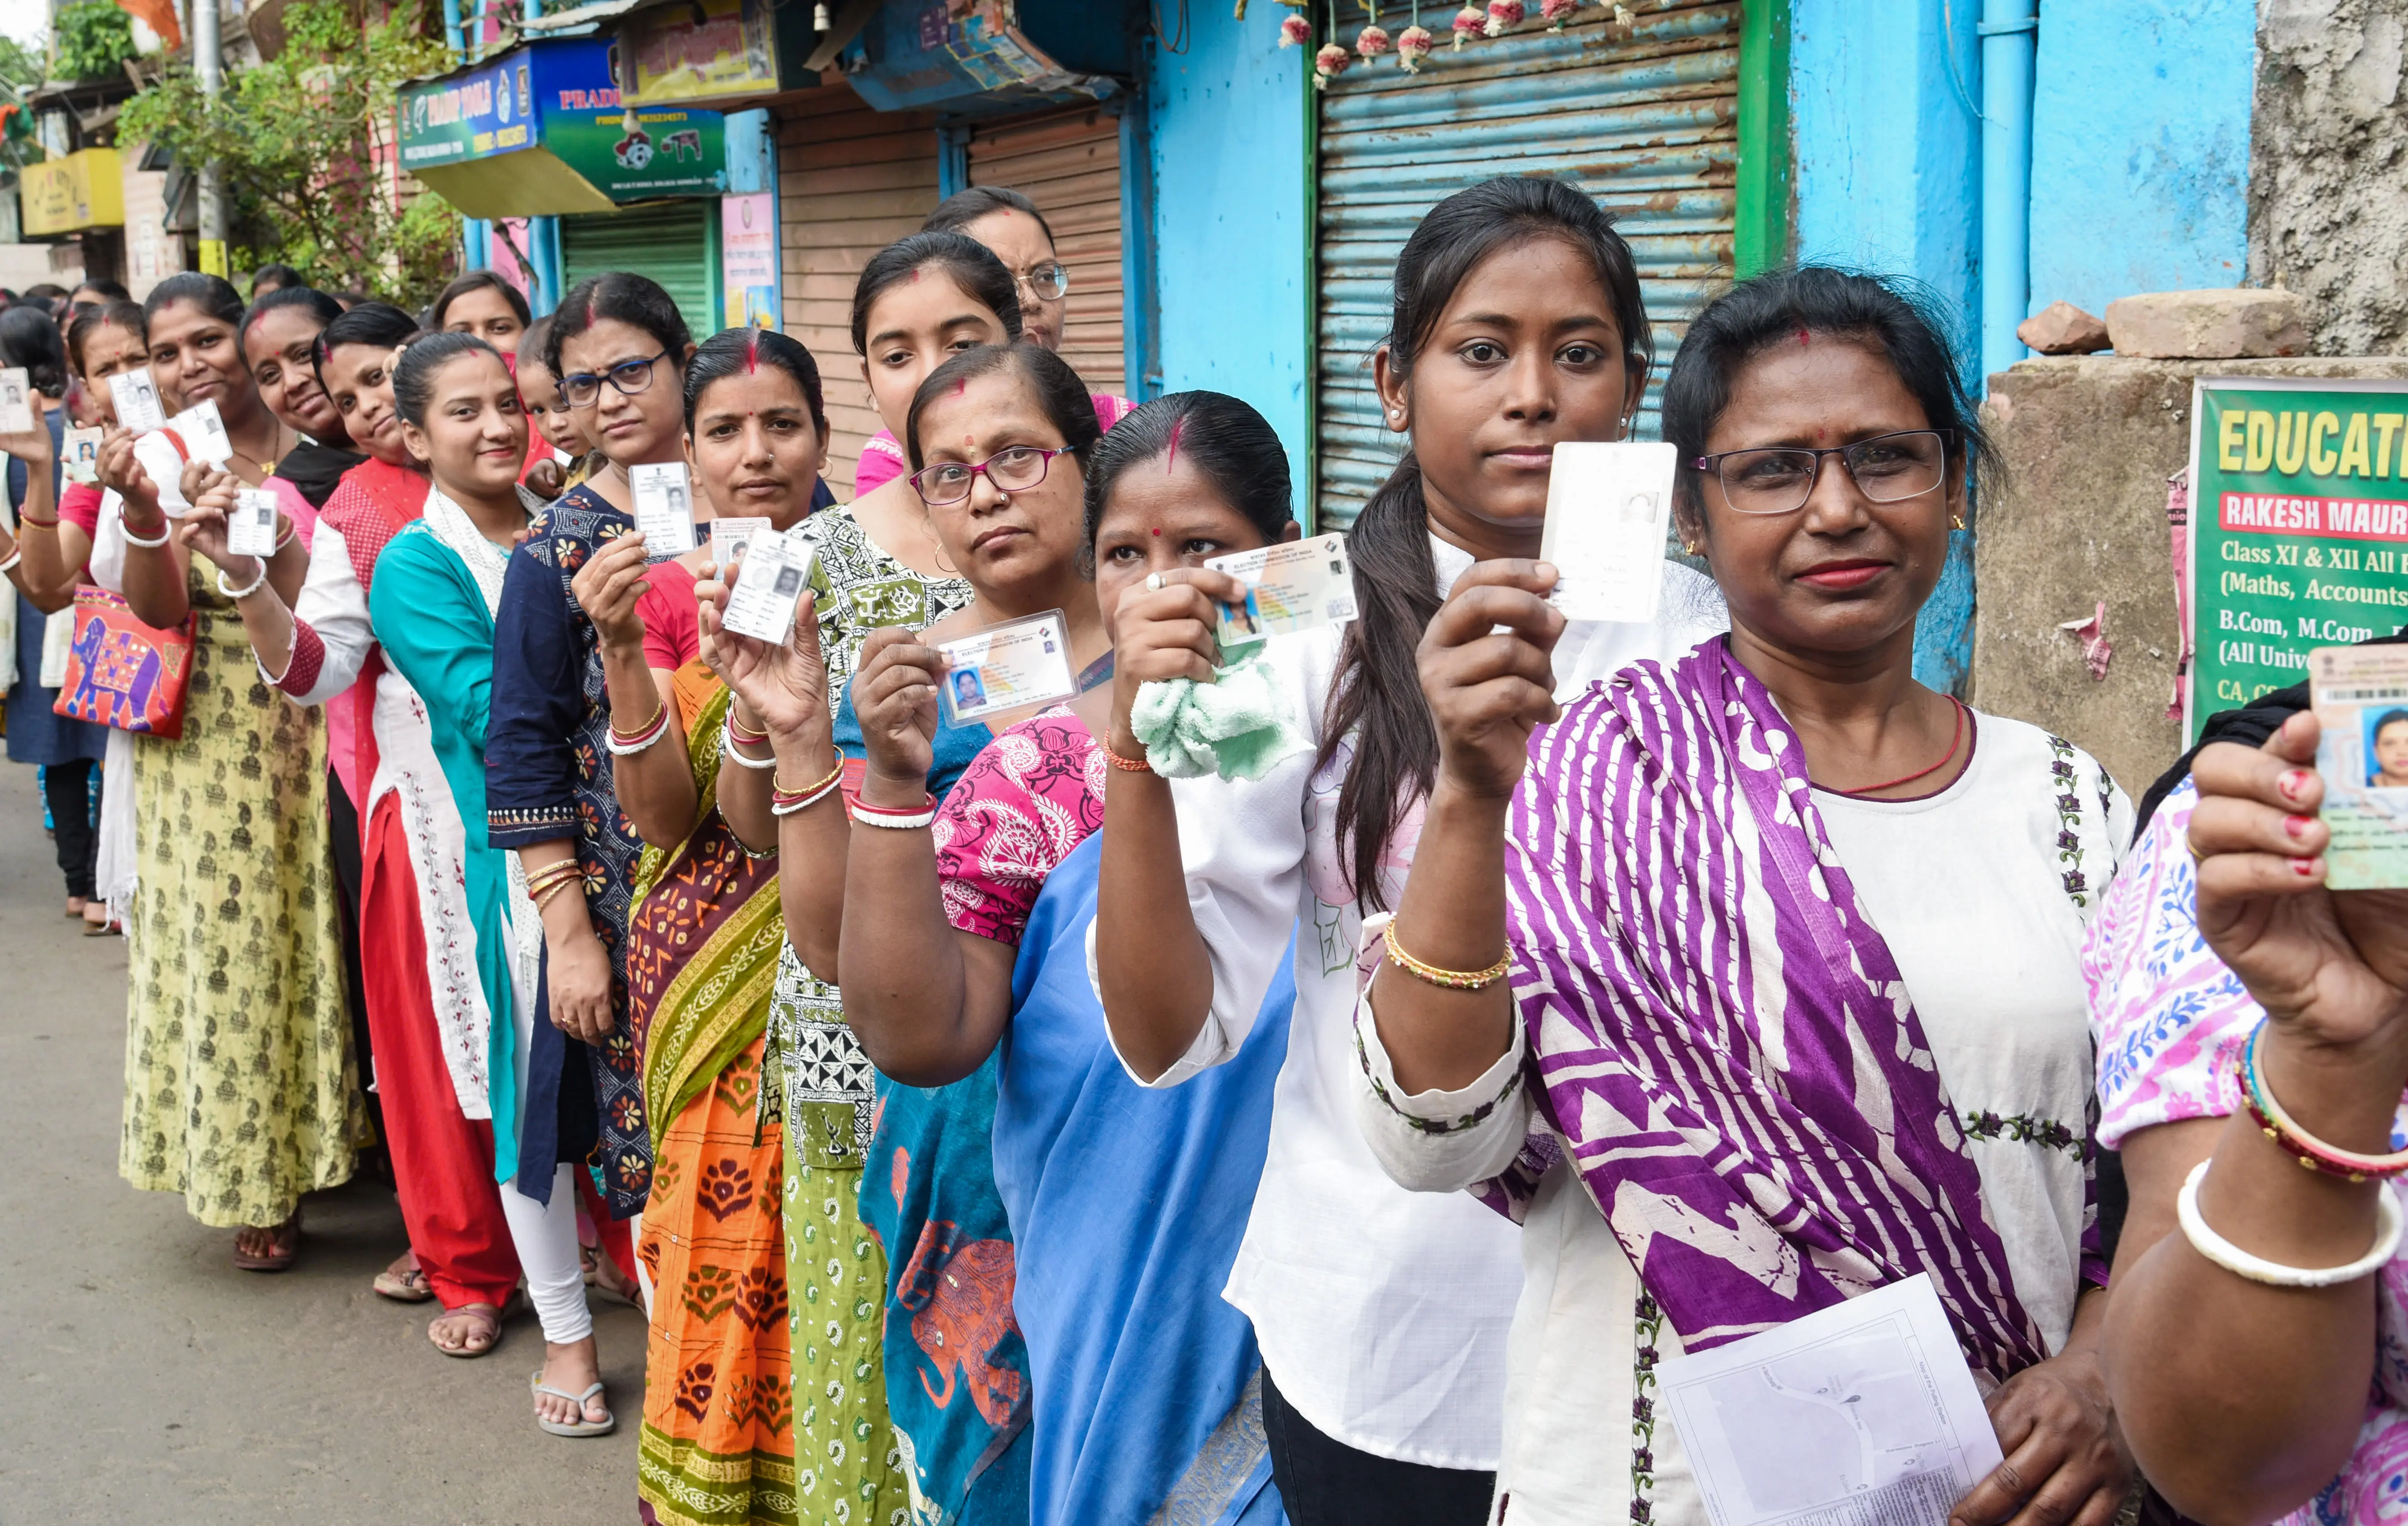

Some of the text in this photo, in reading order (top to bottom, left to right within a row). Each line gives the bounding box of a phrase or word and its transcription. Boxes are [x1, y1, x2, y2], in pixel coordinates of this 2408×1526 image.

[2226, 496, 2408, 535] RAKESH MAUR
[2221, 540, 2271, 564] Class
[2275, 545, 2299, 566] XI
[2304, 547, 2323, 568] &
[2327, 548, 2359, 570] XII
[2364, 551, 2394, 573] All
[2221, 571, 2408, 606] (Maths, Accounts
[2219, 610, 2288, 639] B.Com,
[2219, 640, 2254, 666] (All
